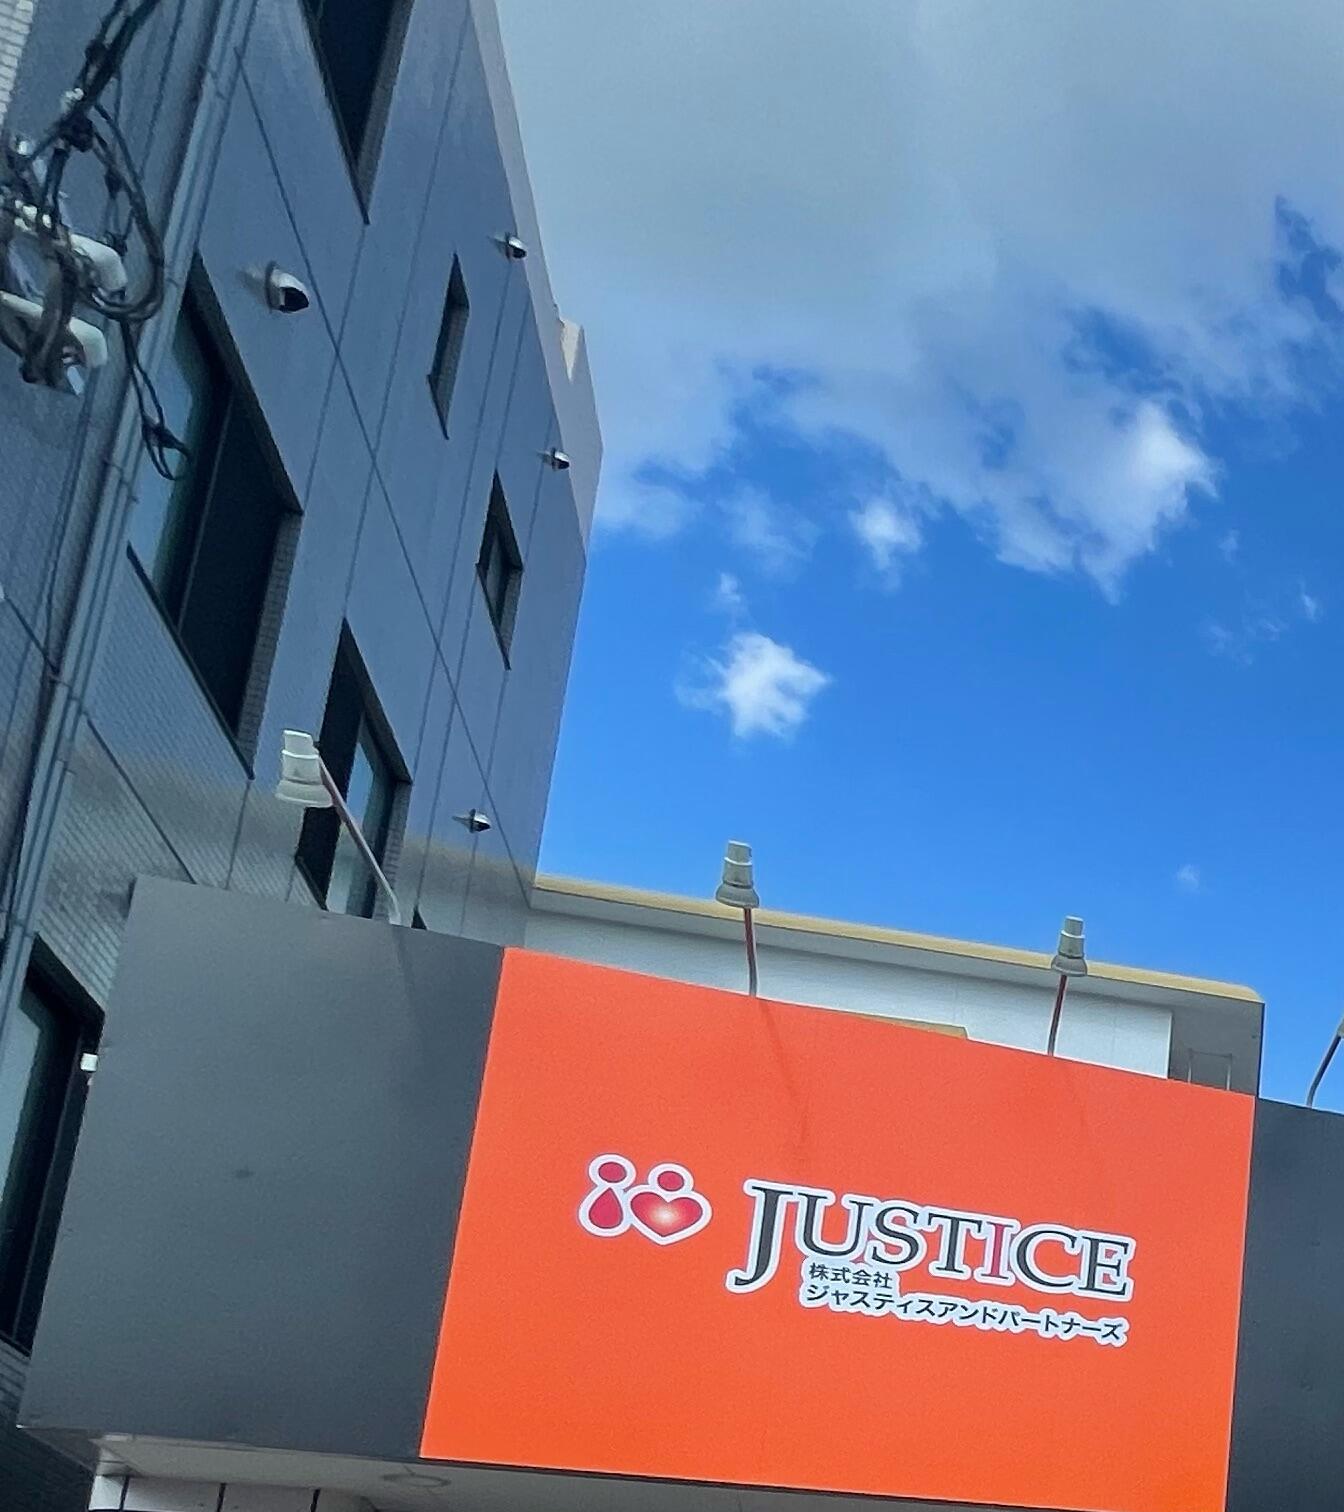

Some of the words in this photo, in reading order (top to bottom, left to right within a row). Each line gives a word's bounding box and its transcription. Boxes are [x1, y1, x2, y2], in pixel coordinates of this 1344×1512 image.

[731, 1184, 1132, 1298] JUSTICE
[808, 1262, 894, 1290] 株式会社
[806, 1285, 1123, 1341] ジャスティスアンドパートナーズ
